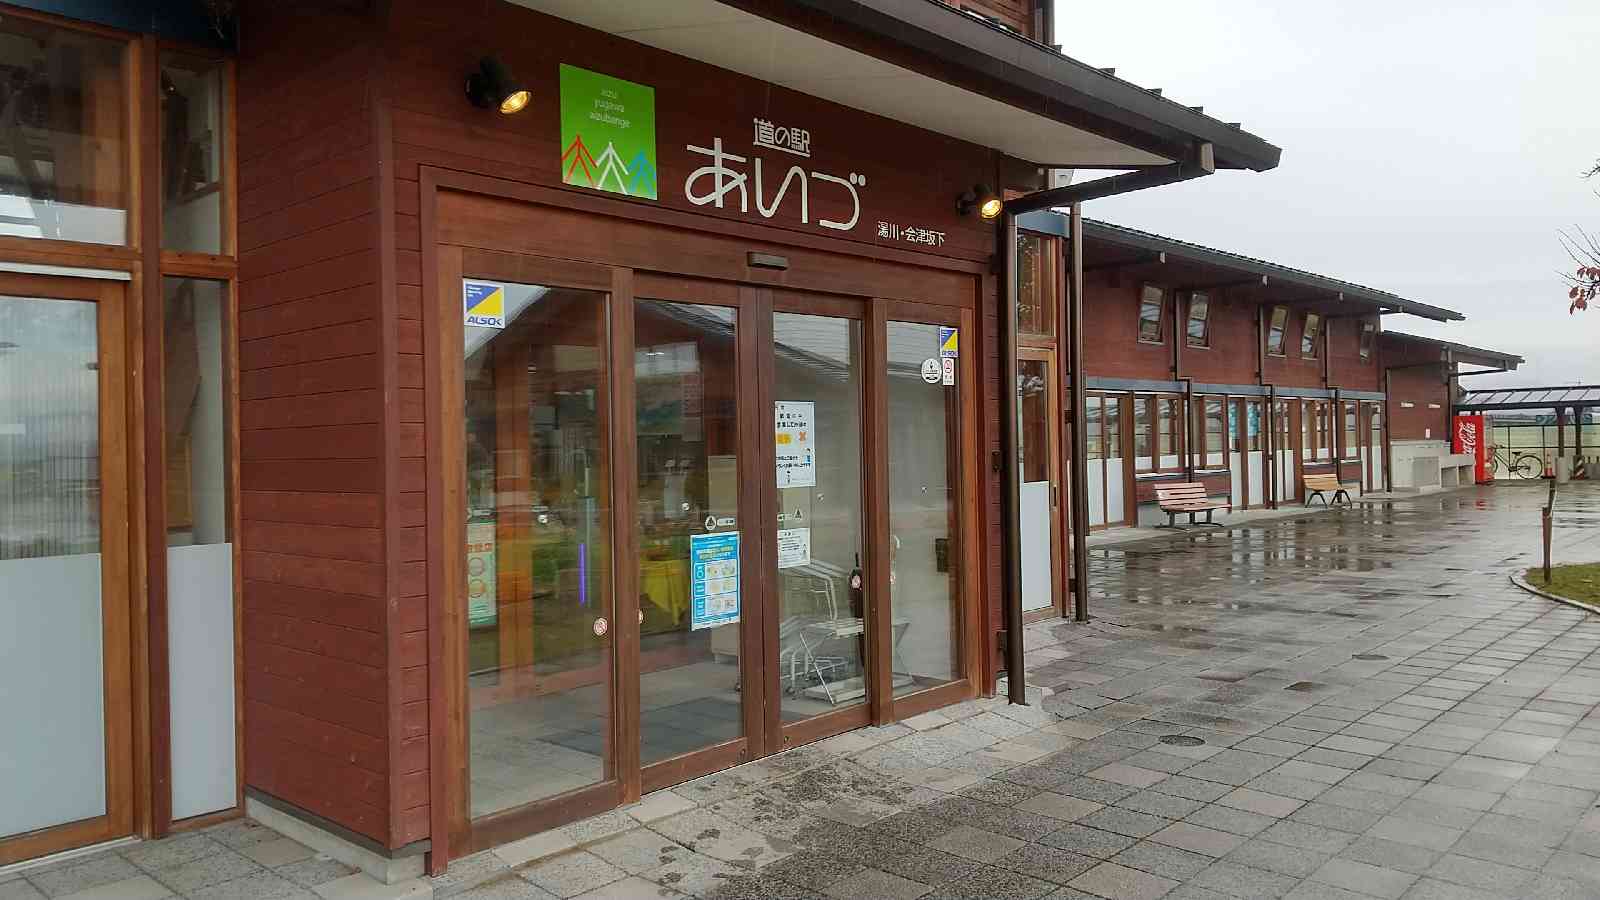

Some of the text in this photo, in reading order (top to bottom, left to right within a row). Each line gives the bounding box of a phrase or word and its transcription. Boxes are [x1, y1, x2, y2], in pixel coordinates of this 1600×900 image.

[753, 117, 810, 157] 道の駅
[684, 137, 867, 231] あいづ
[467, 315, 503, 326] ALSOK
